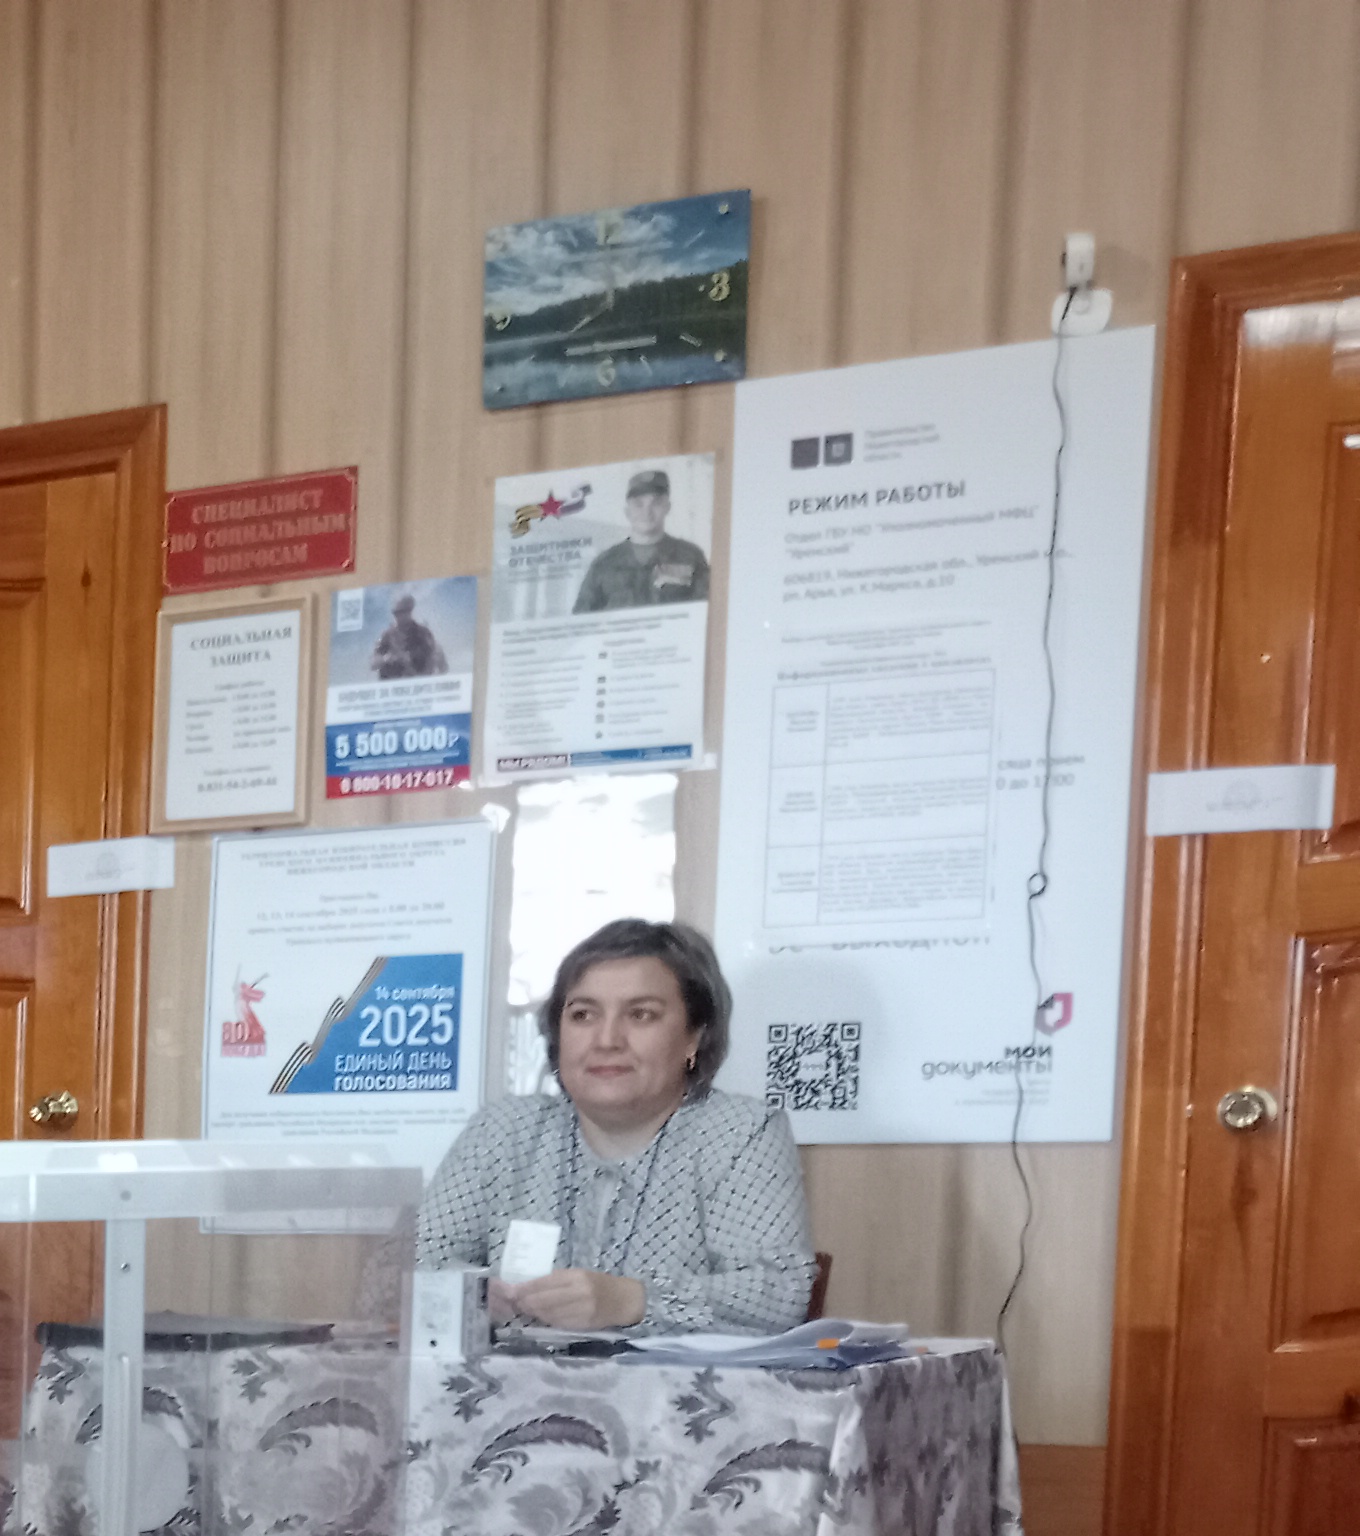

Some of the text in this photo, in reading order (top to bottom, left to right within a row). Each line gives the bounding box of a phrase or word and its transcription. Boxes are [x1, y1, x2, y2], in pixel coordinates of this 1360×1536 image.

[191, 488, 324, 525] СПЕЦИАЛИСТ
[788, 480, 966, 515] РЕЖИМ РАБОТЫ
[169, 513, 347, 554] ПО СОЦИАЛЬНЫМ
[189, 626, 293, 651] СОЦИАЛЬНАЯ
[209, 649, 272, 668] ЗАЩИТА
[334, 733, 350, 760] 5
[355, 729, 399, 758] 500
[374, 983, 456, 1002] 14 сентября
[358, 1002, 455, 1048] 2025
[334, 1049, 453, 1074] ЕДИНЫЙ ДЕНЬ
[1003, 1044, 1053, 1060] мои
[333, 1072, 452, 1093] голосования
